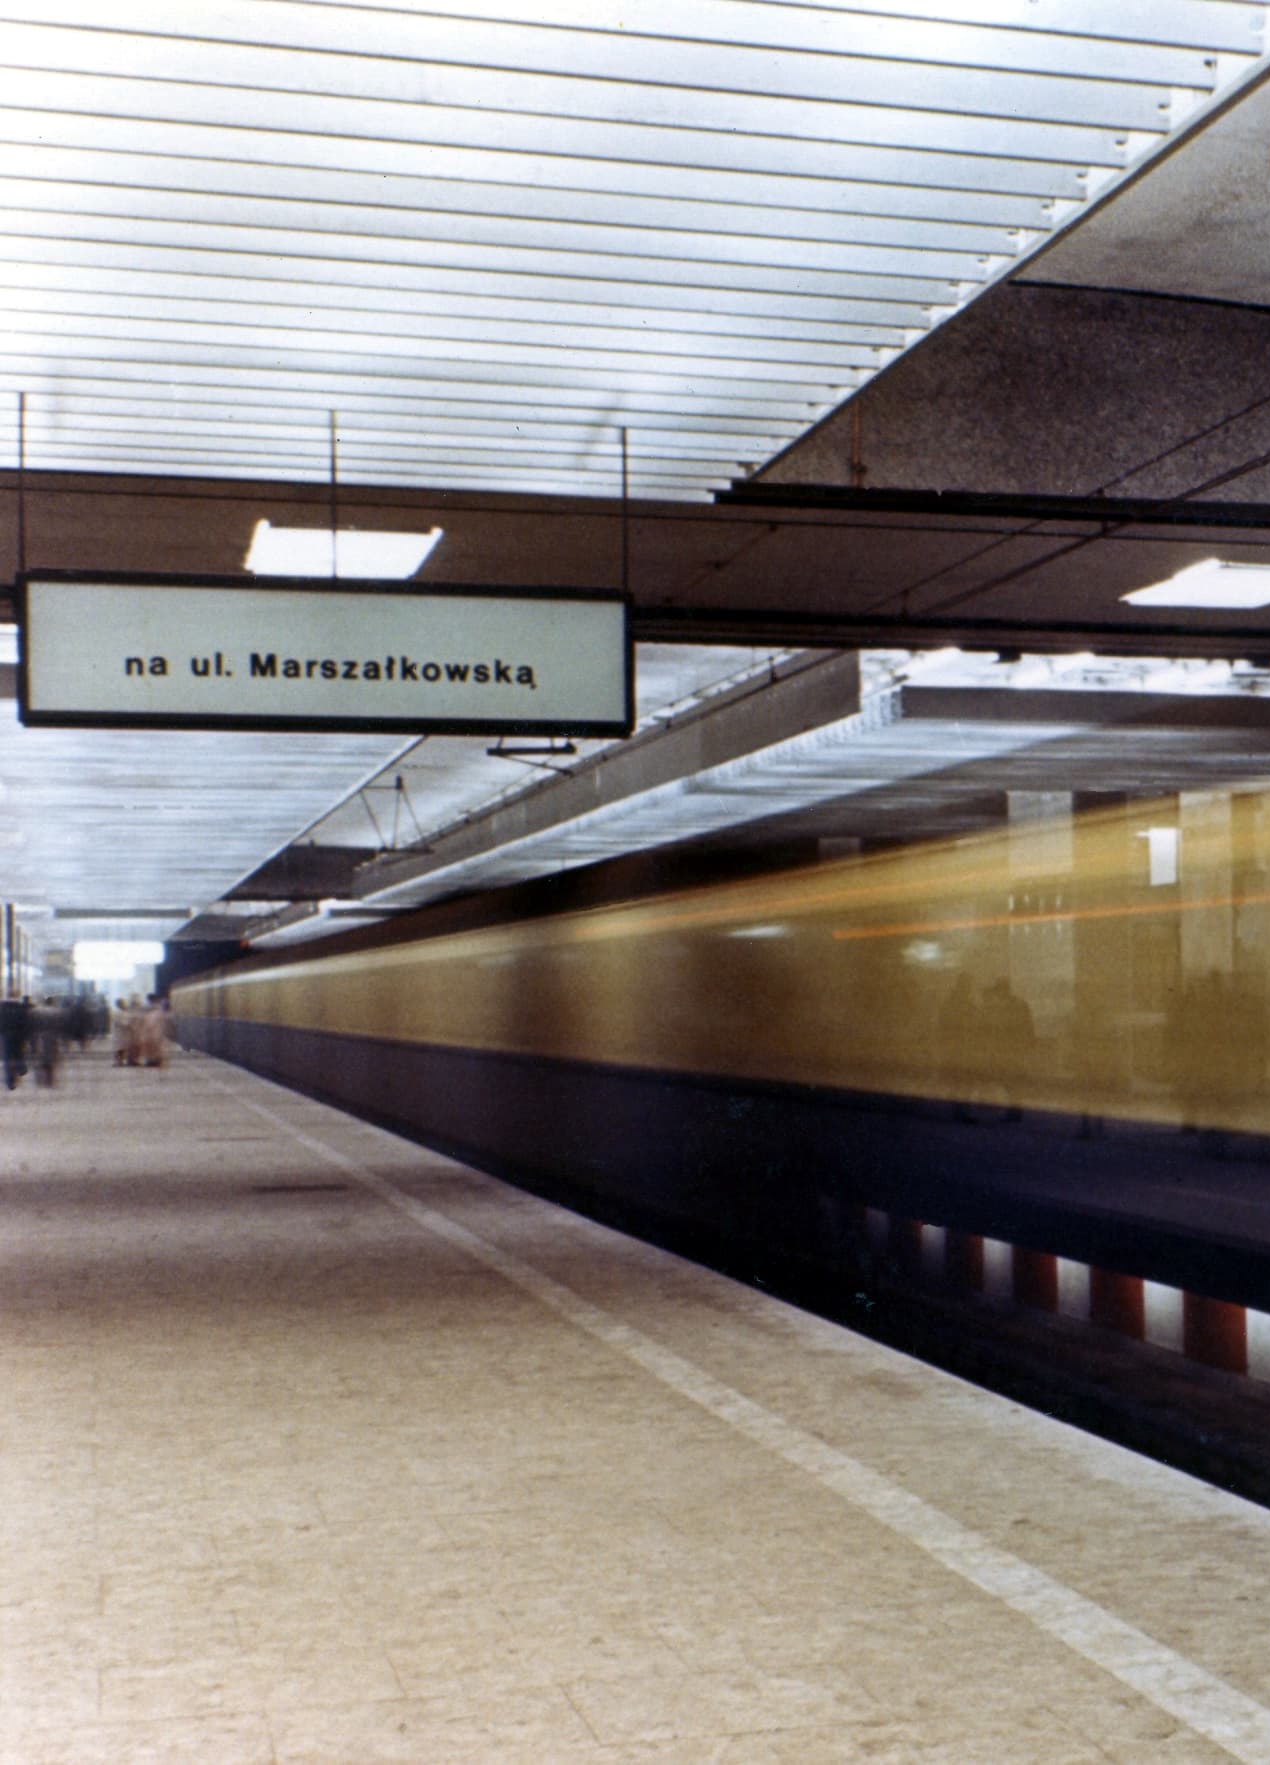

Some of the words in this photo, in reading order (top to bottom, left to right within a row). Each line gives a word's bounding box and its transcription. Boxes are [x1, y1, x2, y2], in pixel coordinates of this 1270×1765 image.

[124, 655, 168, 676] na
[190, 652, 233, 677] ul.
[250, 653, 538, 689] Marszałkowską
